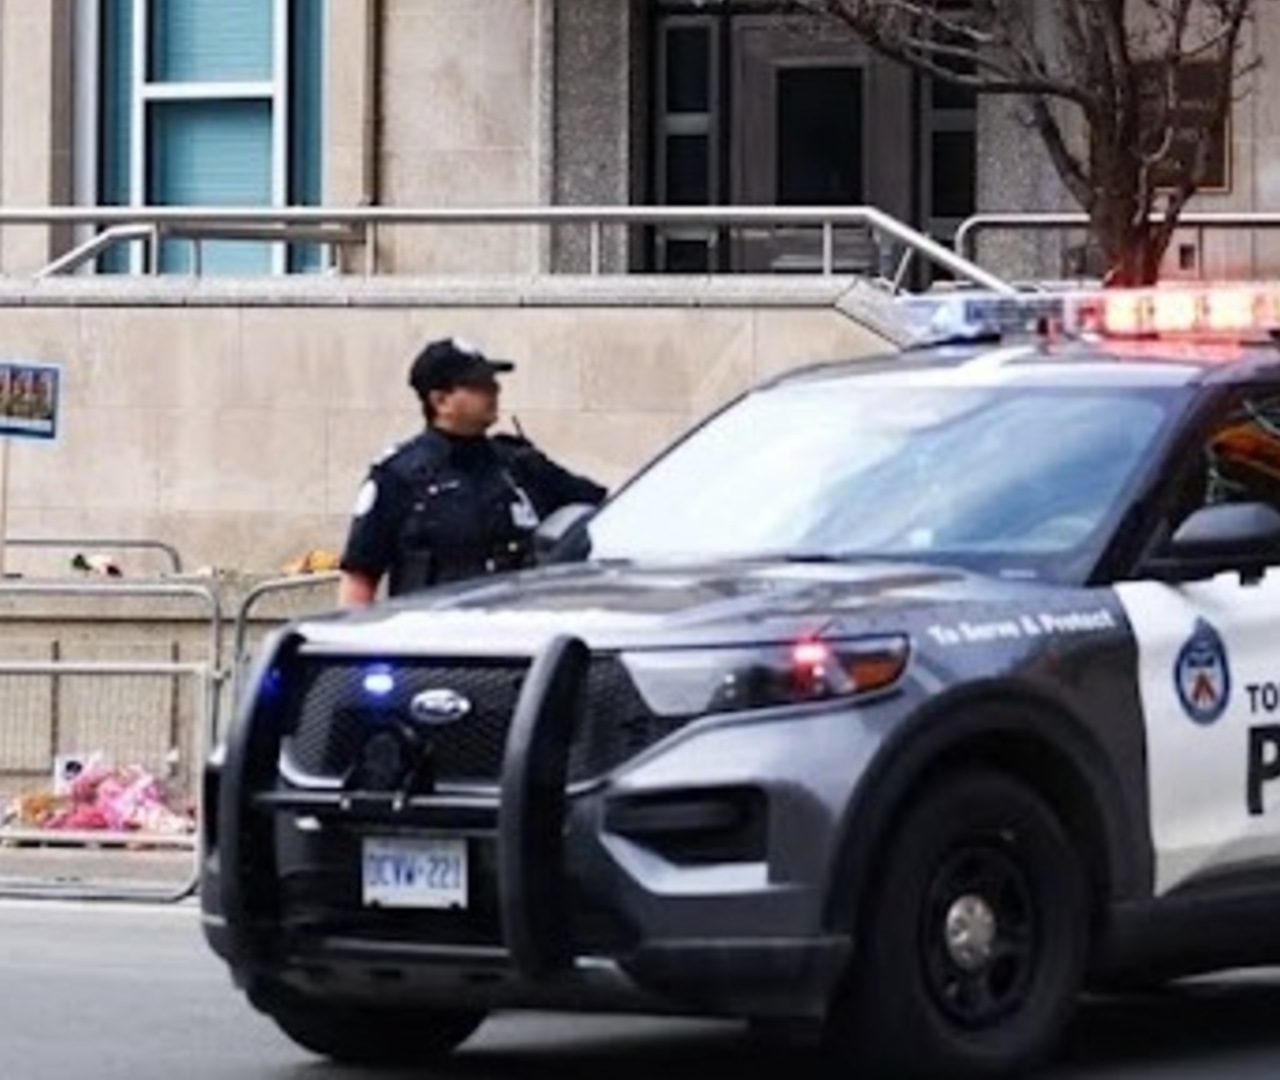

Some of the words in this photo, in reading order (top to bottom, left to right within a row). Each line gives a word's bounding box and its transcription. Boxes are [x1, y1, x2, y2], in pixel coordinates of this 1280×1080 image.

[927, 625, 960, 645] To
[959, 622, 1020, 642] Serve
[1021, 615, 1041, 636] &
[1038, 608, 1117, 632] Protect
